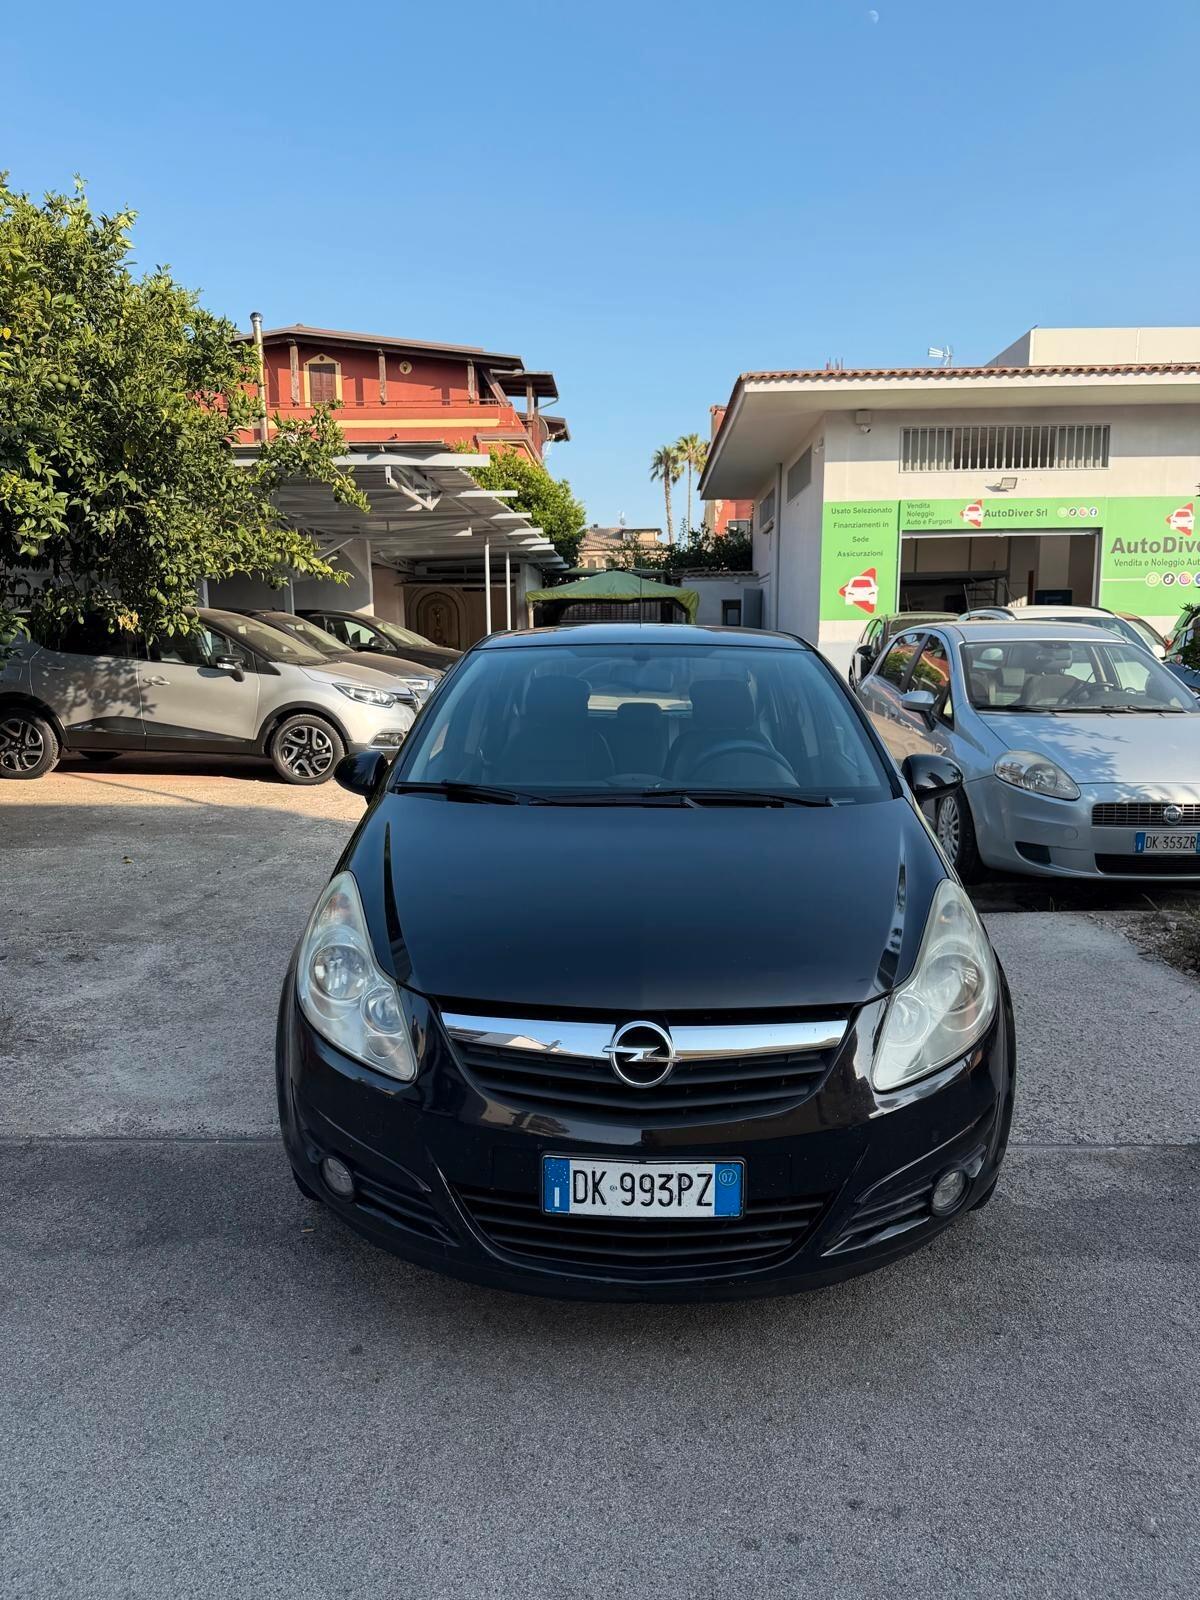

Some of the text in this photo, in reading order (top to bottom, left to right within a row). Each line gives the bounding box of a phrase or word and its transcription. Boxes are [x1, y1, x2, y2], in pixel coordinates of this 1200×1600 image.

[853, 507, 893, 515] Selezionato
[906, 502, 931, 510] Vendita
[906, 510, 935, 518] Noleggio
[983, 508, 1048, 518] AutoDiver Srl
[906, 518, 922, 526] Auto
[928, 518, 953, 526] Furgoni
[1111, 537, 1200, 554] AutoDiv
[837, 550, 883, 558] Assicurazioni
[1114, 559, 1142, 567] Vendita
[1151, 558, 1185, 568] Noleggio
[1145, 836, 1159, 849] DK
[721, 1172, 734, 1183] 07
[572, 1170, 714, 1207] DK 993PZ
